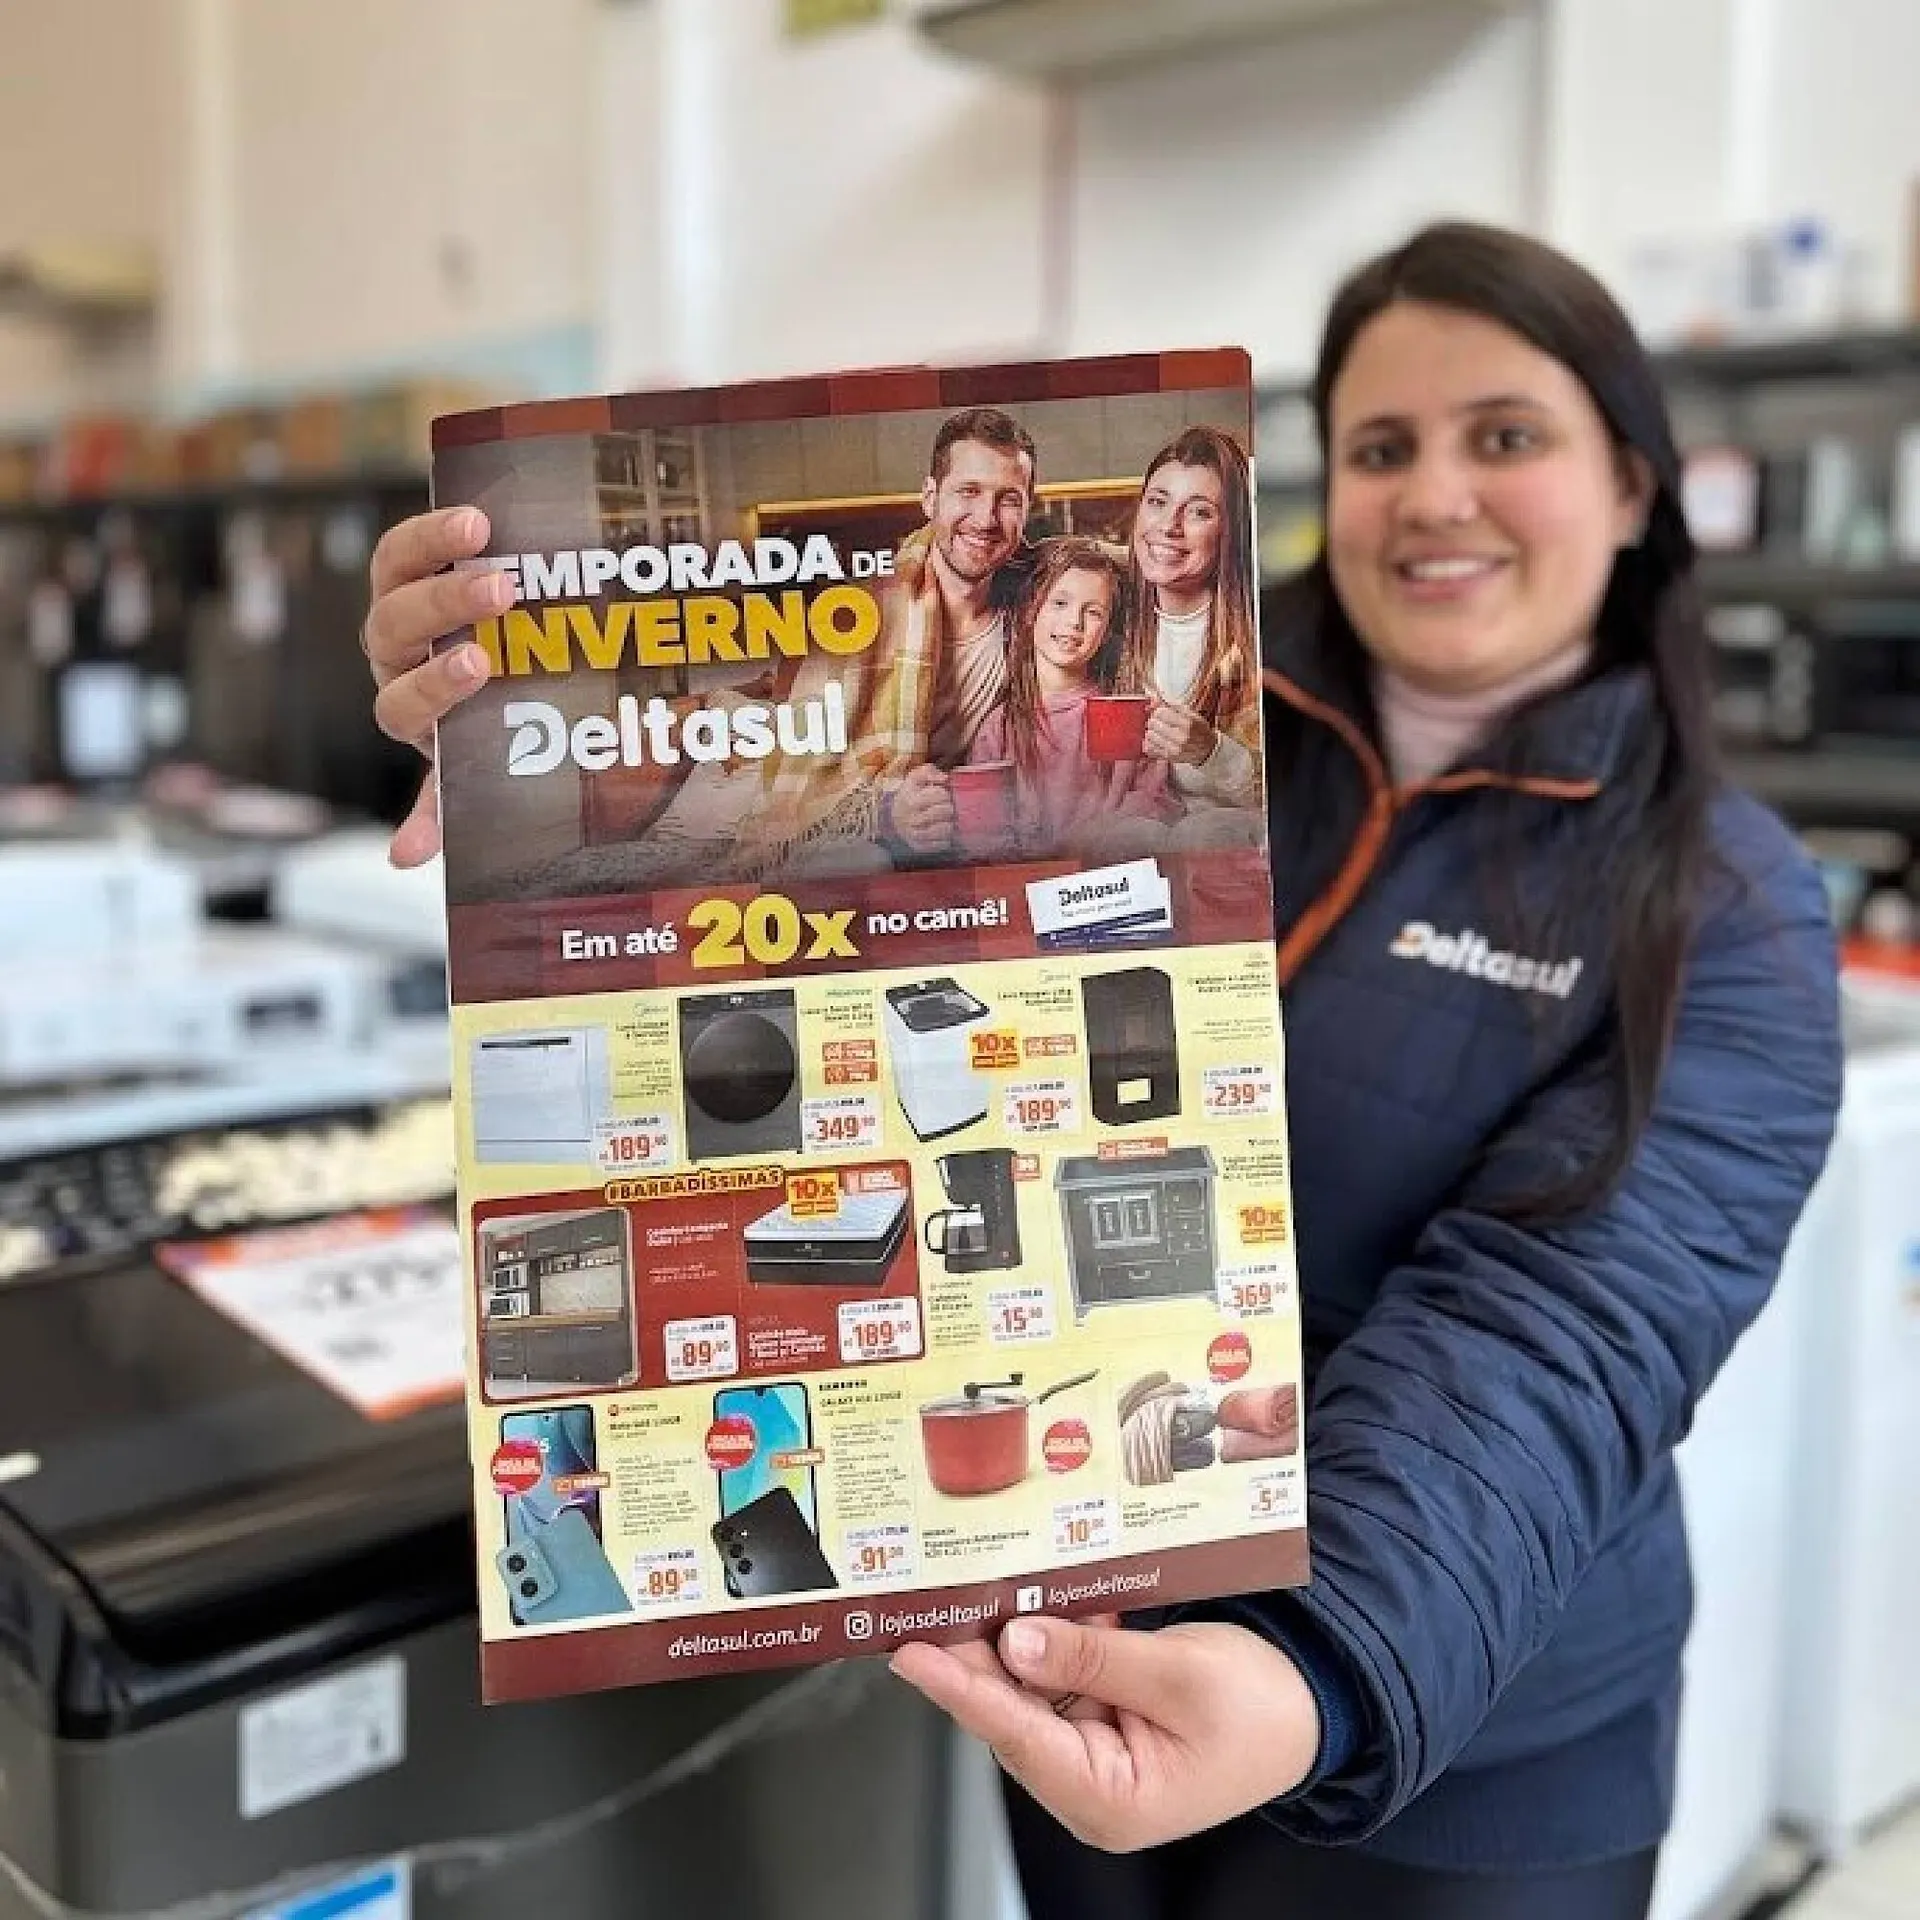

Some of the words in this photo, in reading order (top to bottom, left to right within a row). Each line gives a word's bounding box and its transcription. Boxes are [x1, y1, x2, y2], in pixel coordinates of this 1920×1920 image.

[454, 534, 846, 601] EMPORADA
[851, 547, 896, 578] DE
[475, 585, 880, 678] INVERNO
[503, 680, 848, 777] Deltasul
[561, 929, 617, 960] Em
[624, 921, 679, 956] até
[686, 893, 861, 969] 20x
[867, 912, 909, 935] no
[790, 1177, 838, 1200] 10x
[667, 1622, 822, 1659] deltasul.com.br
[878, 1597, 1000, 1638] lojasdeltasul
